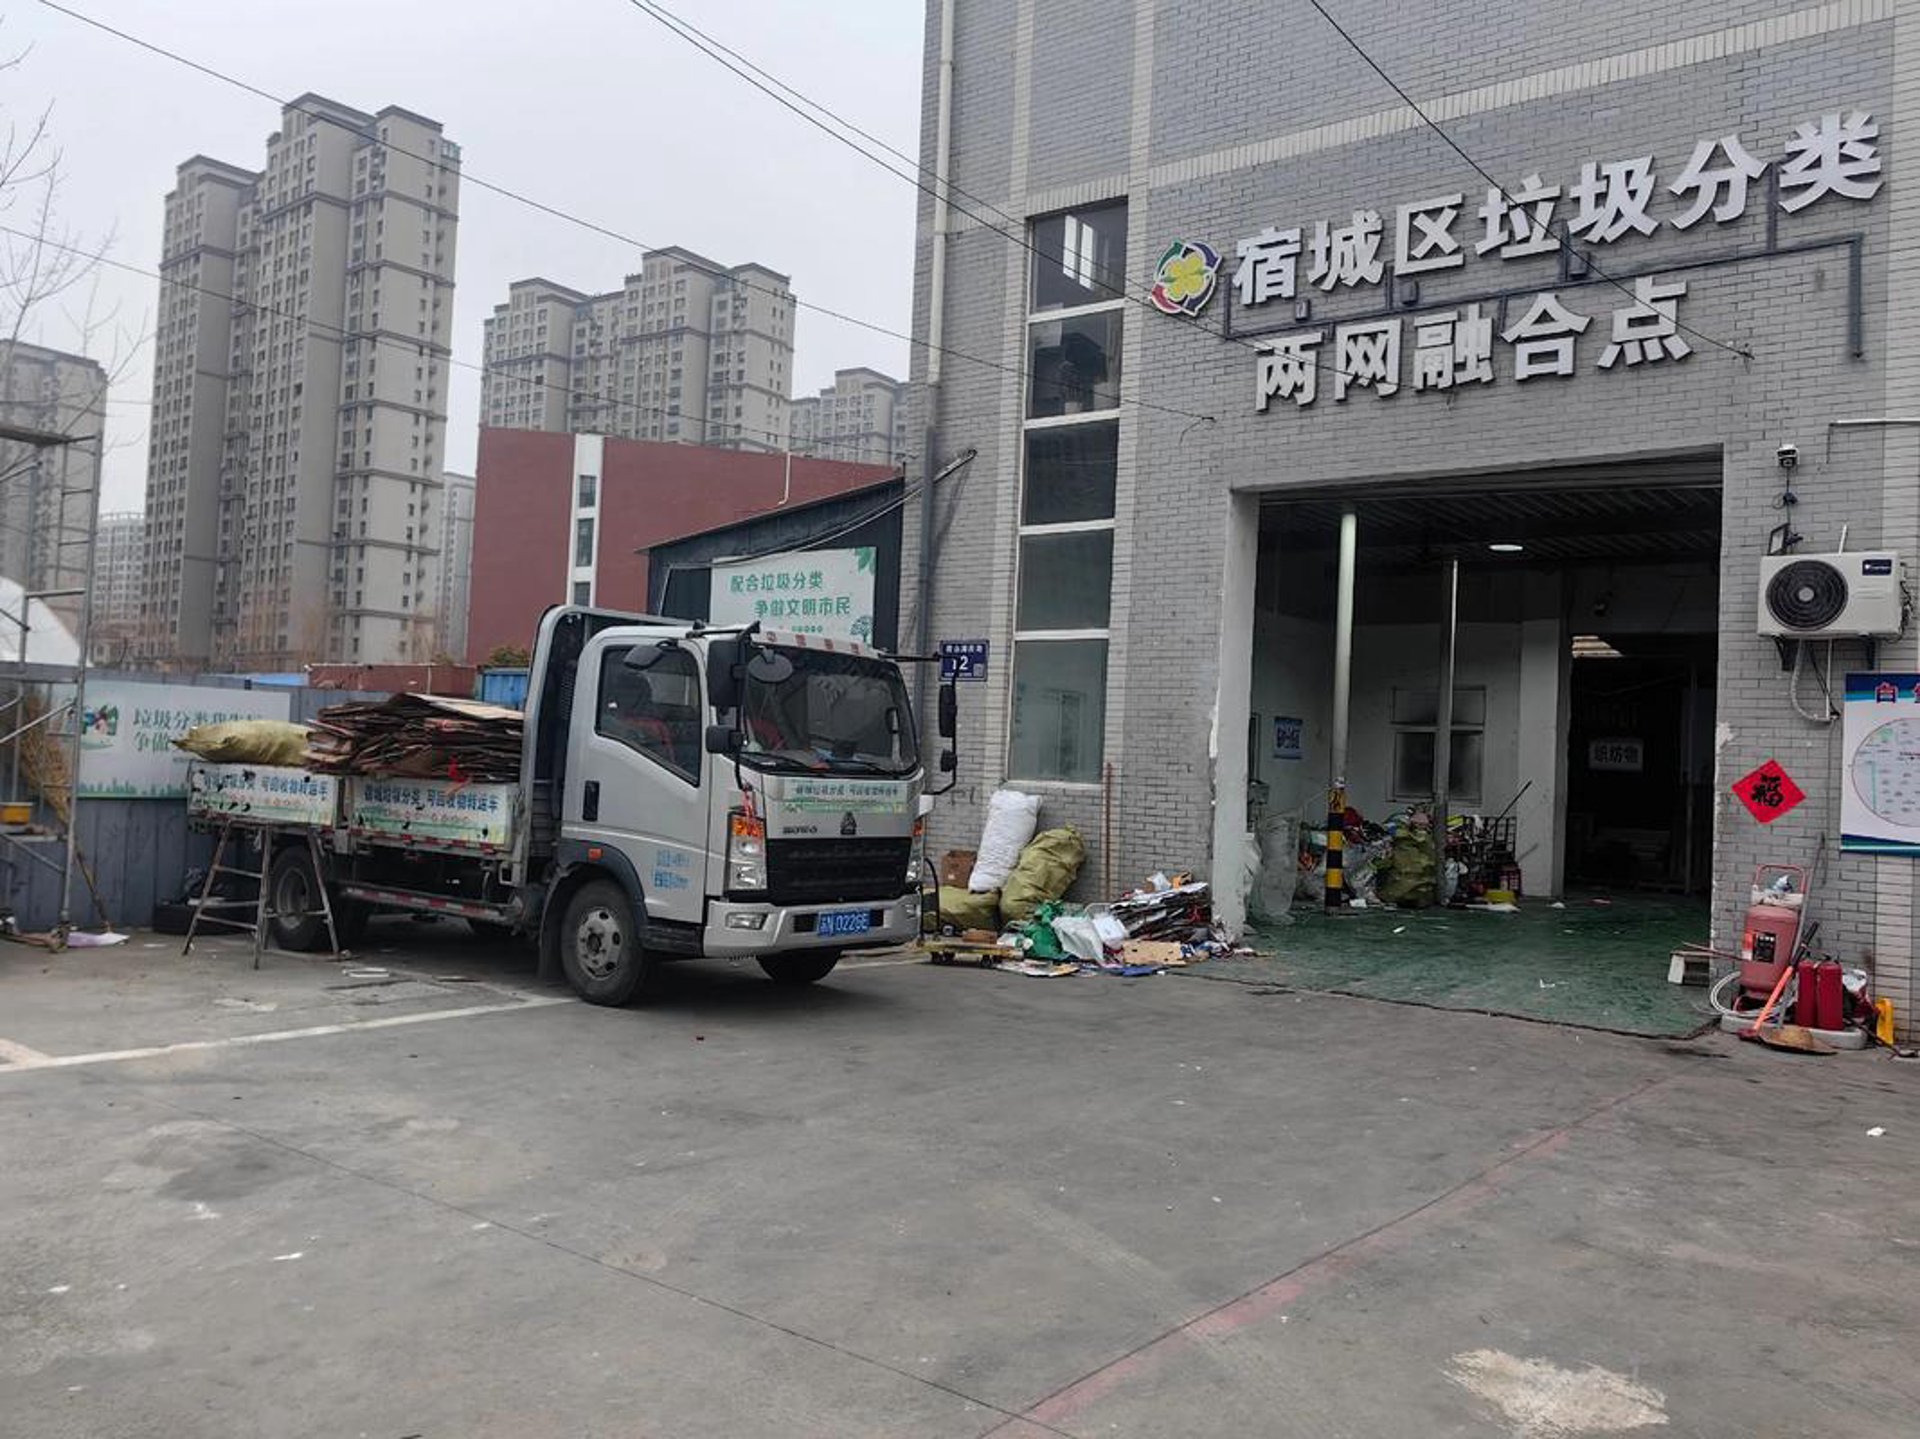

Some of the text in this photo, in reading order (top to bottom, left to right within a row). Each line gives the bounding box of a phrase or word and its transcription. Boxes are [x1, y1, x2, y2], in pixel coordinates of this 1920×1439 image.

[1233, 111, 1885, 306] 宿城区垃圾分类
[1255, 276, 1693, 412] 两网融合点
[730, 570, 824, 593] 配合垃圾分类
[755, 596, 851, 618] 争做文明市民
[1751, 773, 1784, 807] 福
